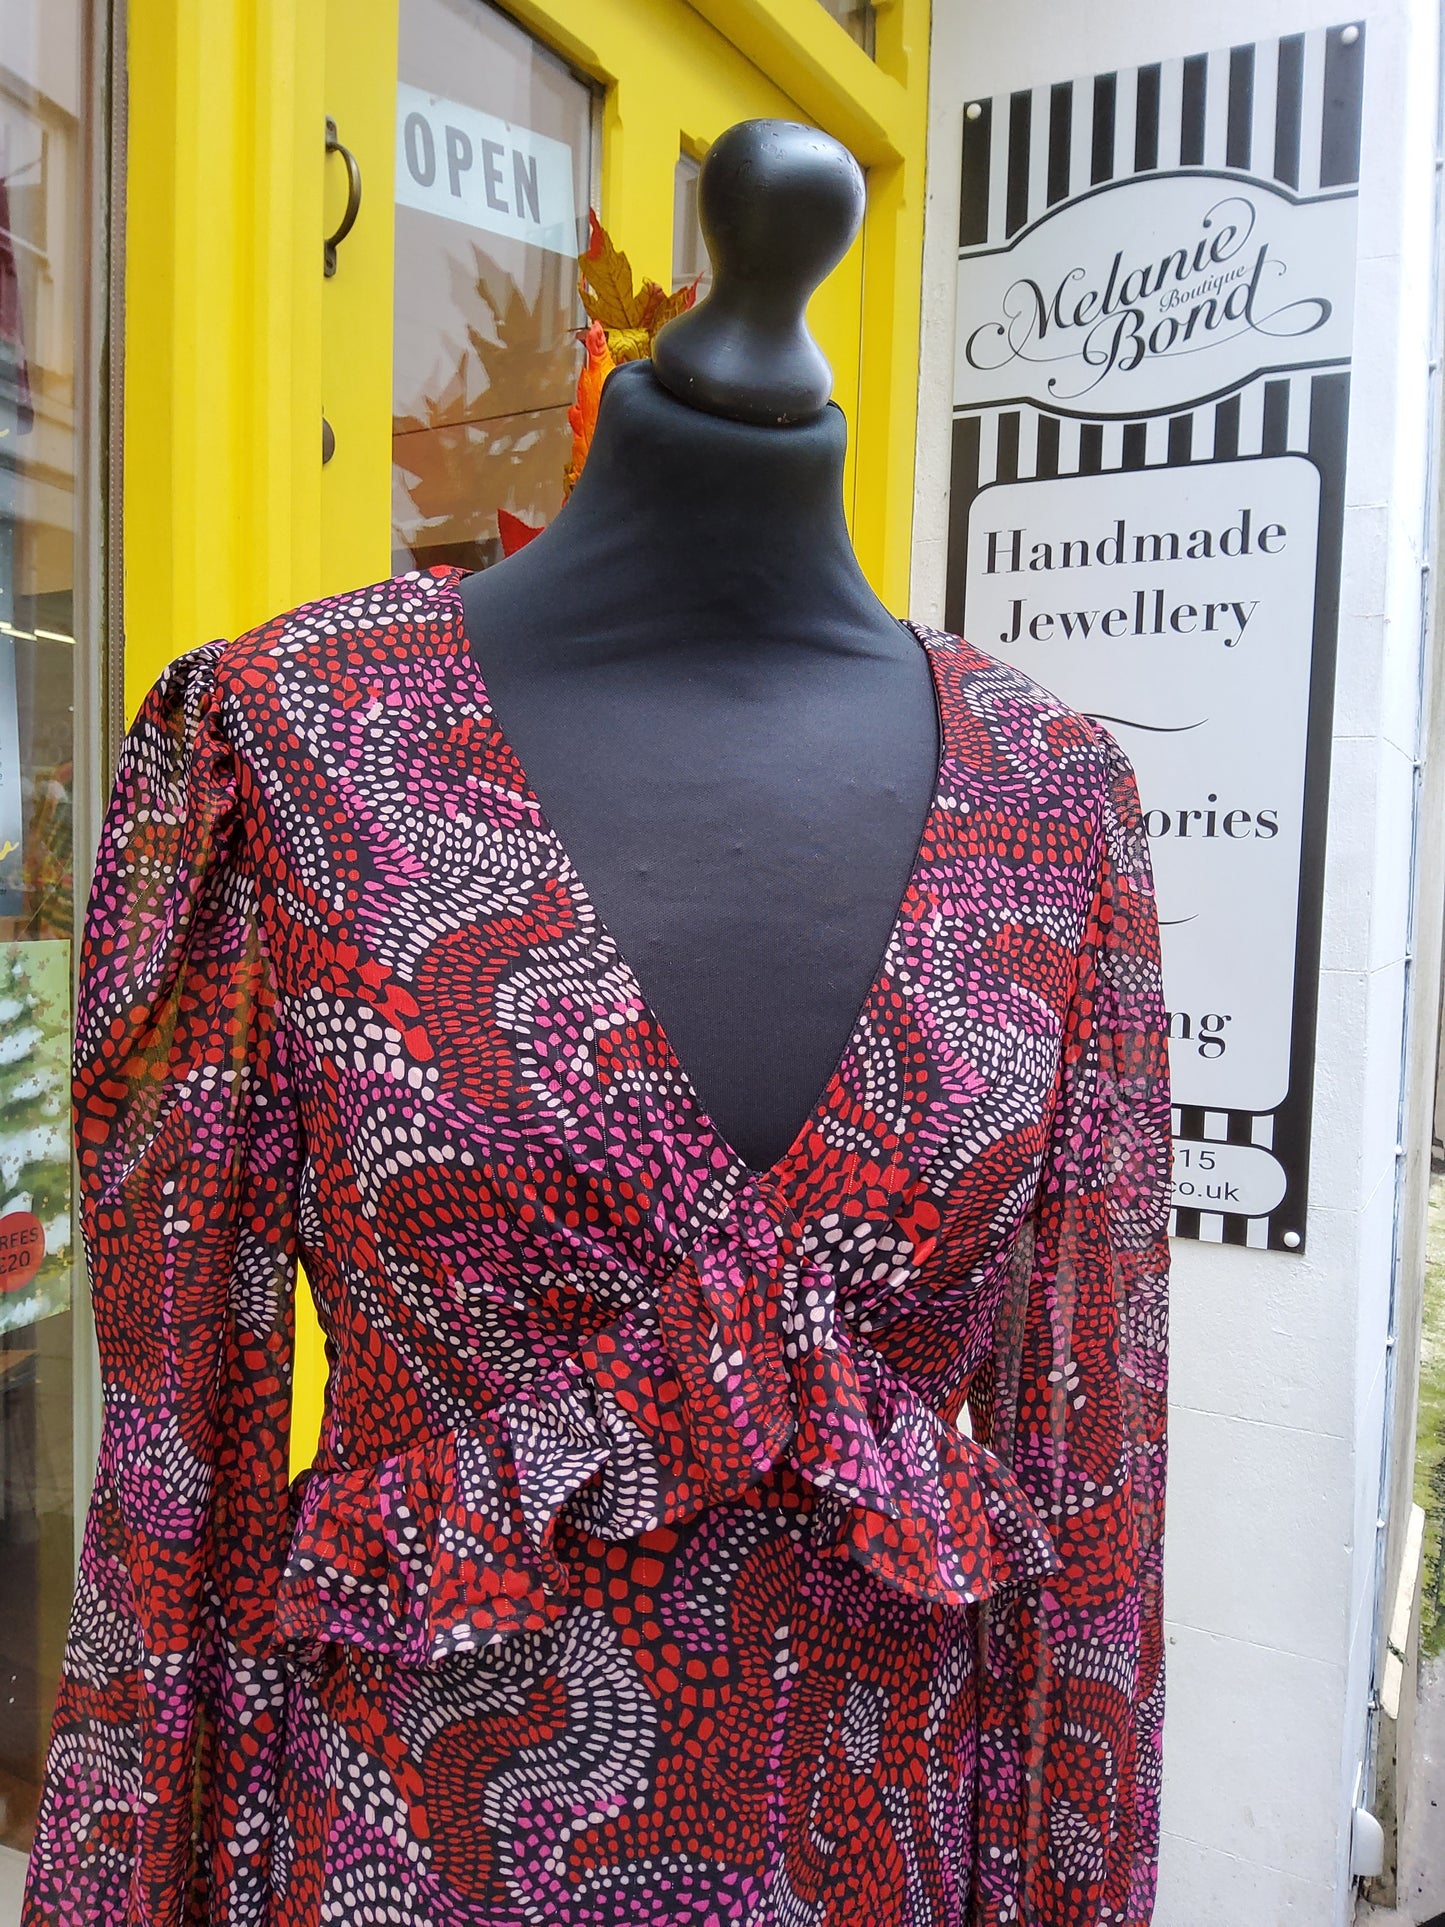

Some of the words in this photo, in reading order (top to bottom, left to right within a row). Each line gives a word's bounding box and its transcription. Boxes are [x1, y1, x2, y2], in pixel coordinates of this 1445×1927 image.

[404, 112, 541, 224] OPEN
[1000, 197, 1257, 345] Melanie
[1159, 264, 1248, 313] Boutique
[1078, 243, 1290, 382] Bond
[981, 509, 1287, 575] Handmade
[1000, 589, 1261, 647] Jewellery
[1172, 1147, 1216, 1170] 15
